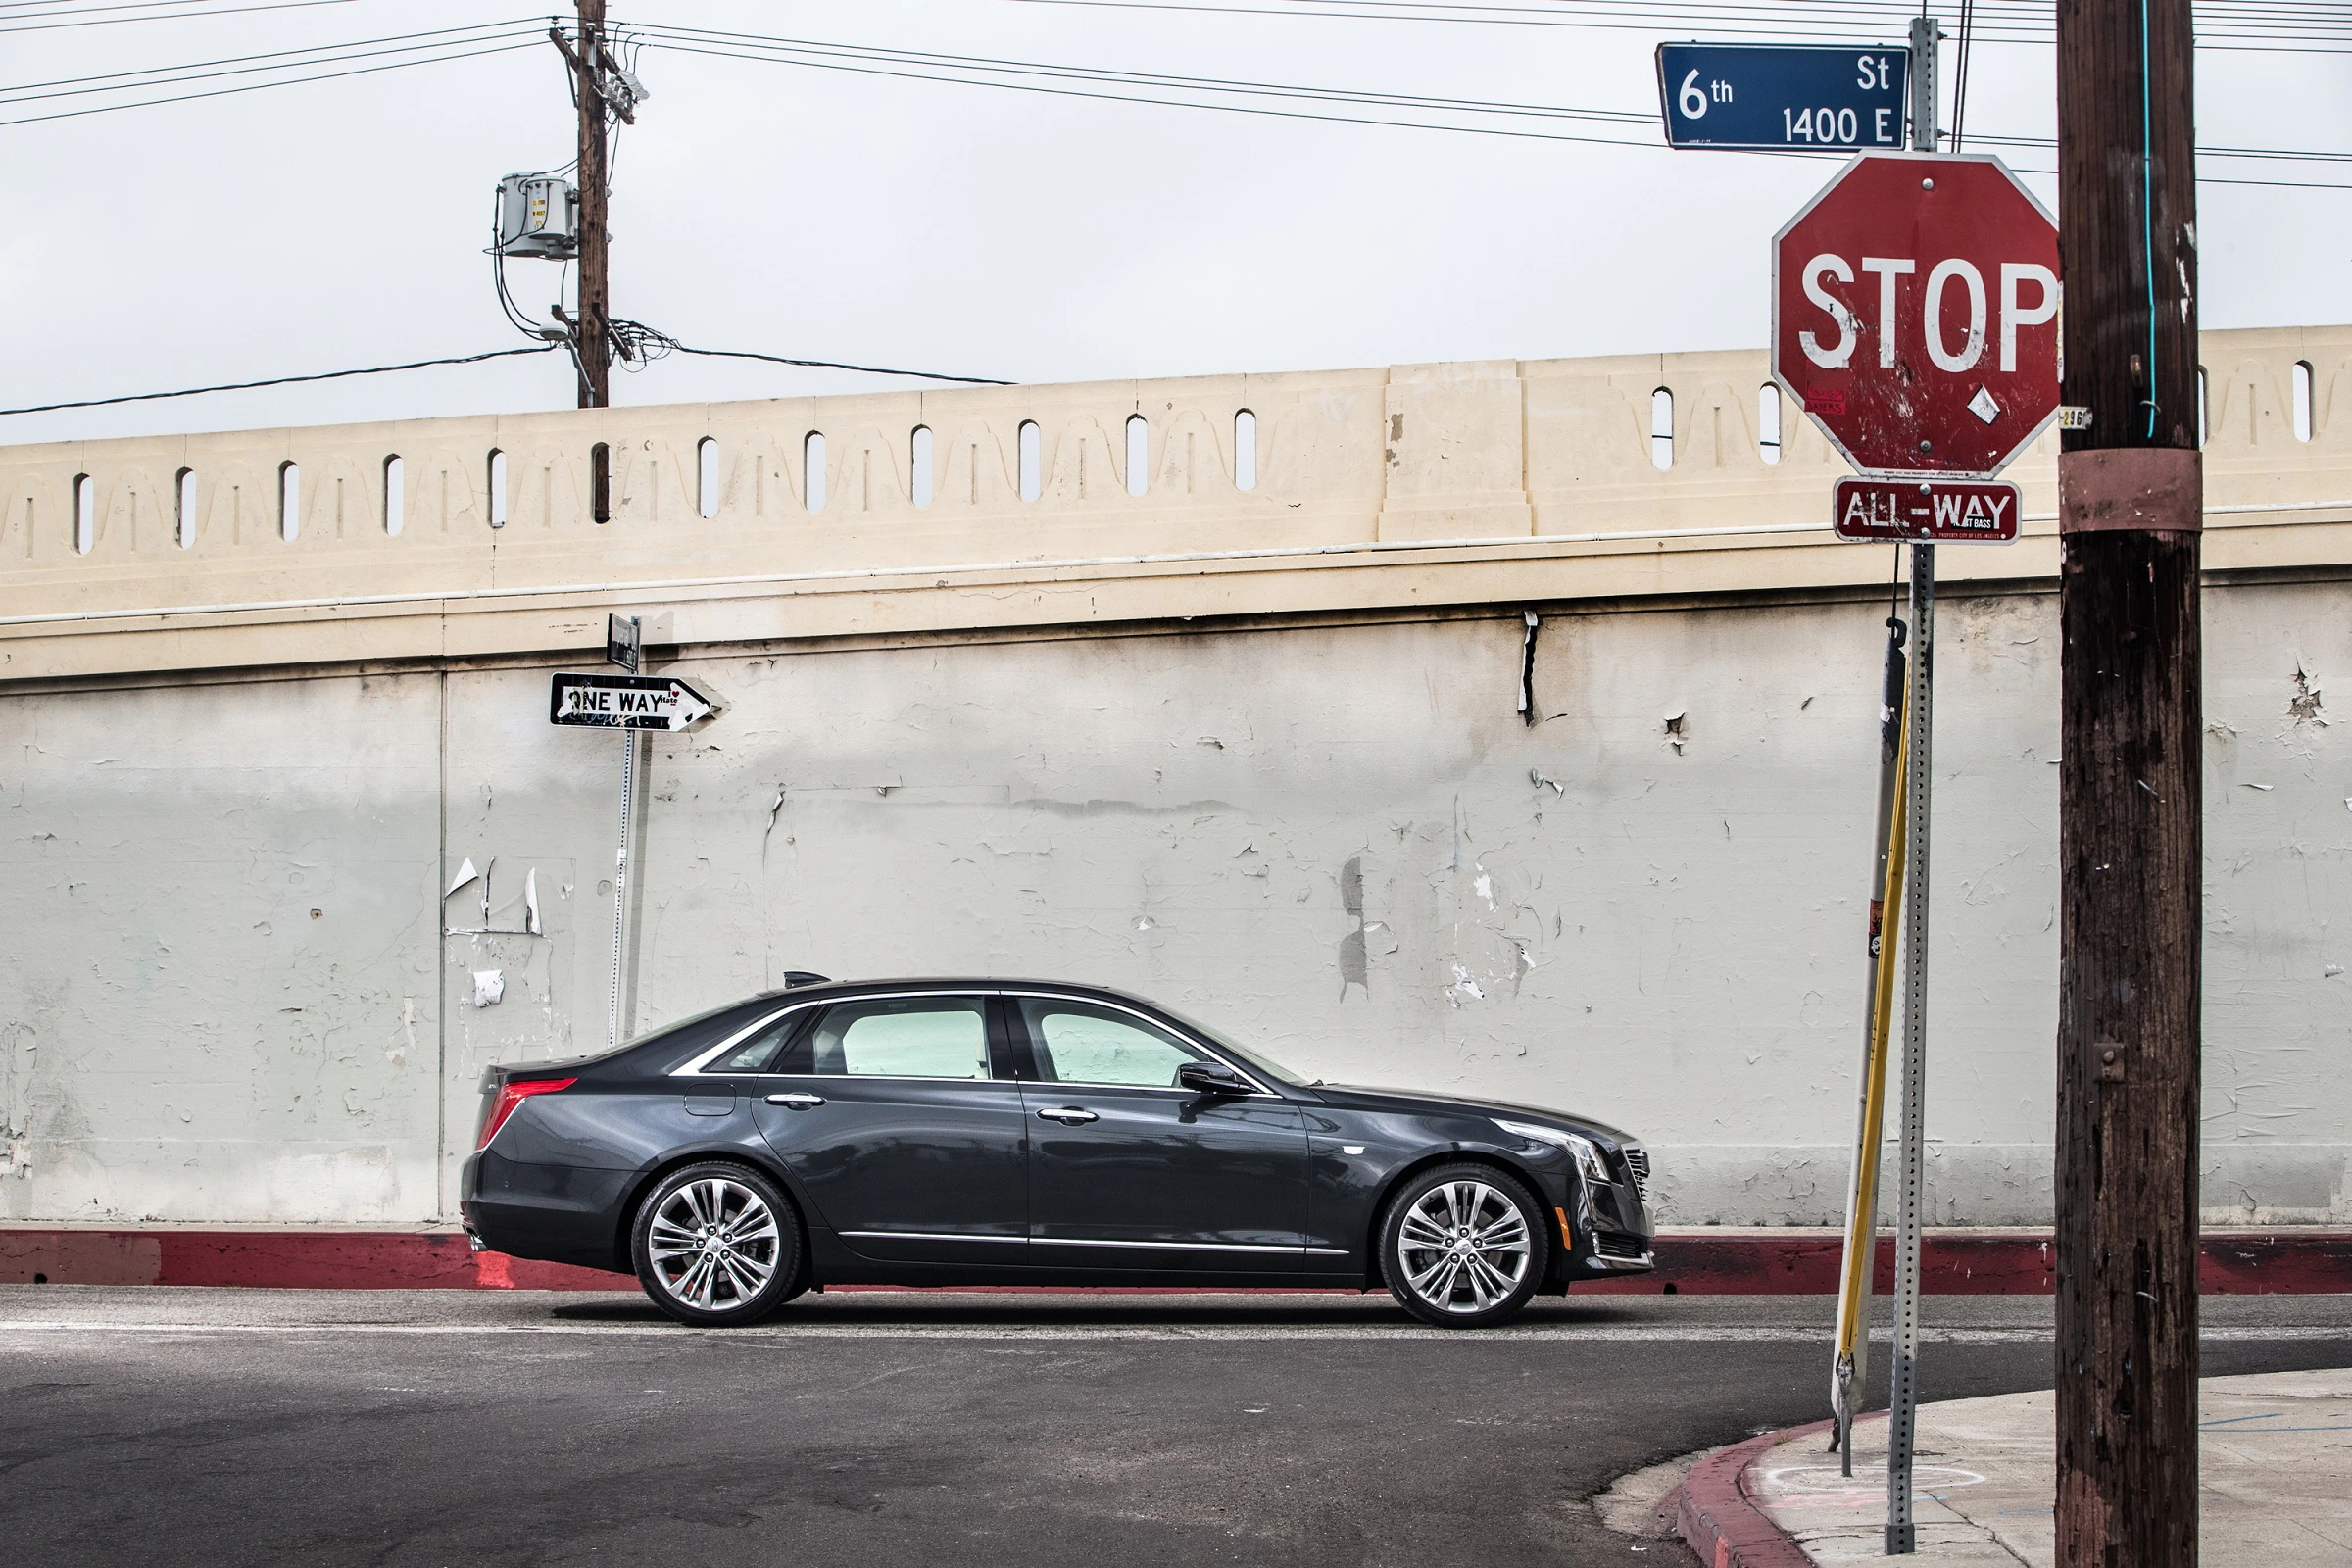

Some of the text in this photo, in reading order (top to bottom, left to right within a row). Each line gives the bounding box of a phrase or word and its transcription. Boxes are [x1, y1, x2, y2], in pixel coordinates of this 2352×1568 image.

[1679, 55, 1890, 120] 6th St
[1783, 107, 1893, 143] 1400 E
[1798, 253, 2059, 372] STOP
[1974, 518, 1992, 529] BASS
[568, 690, 662, 713] ONE WAY
